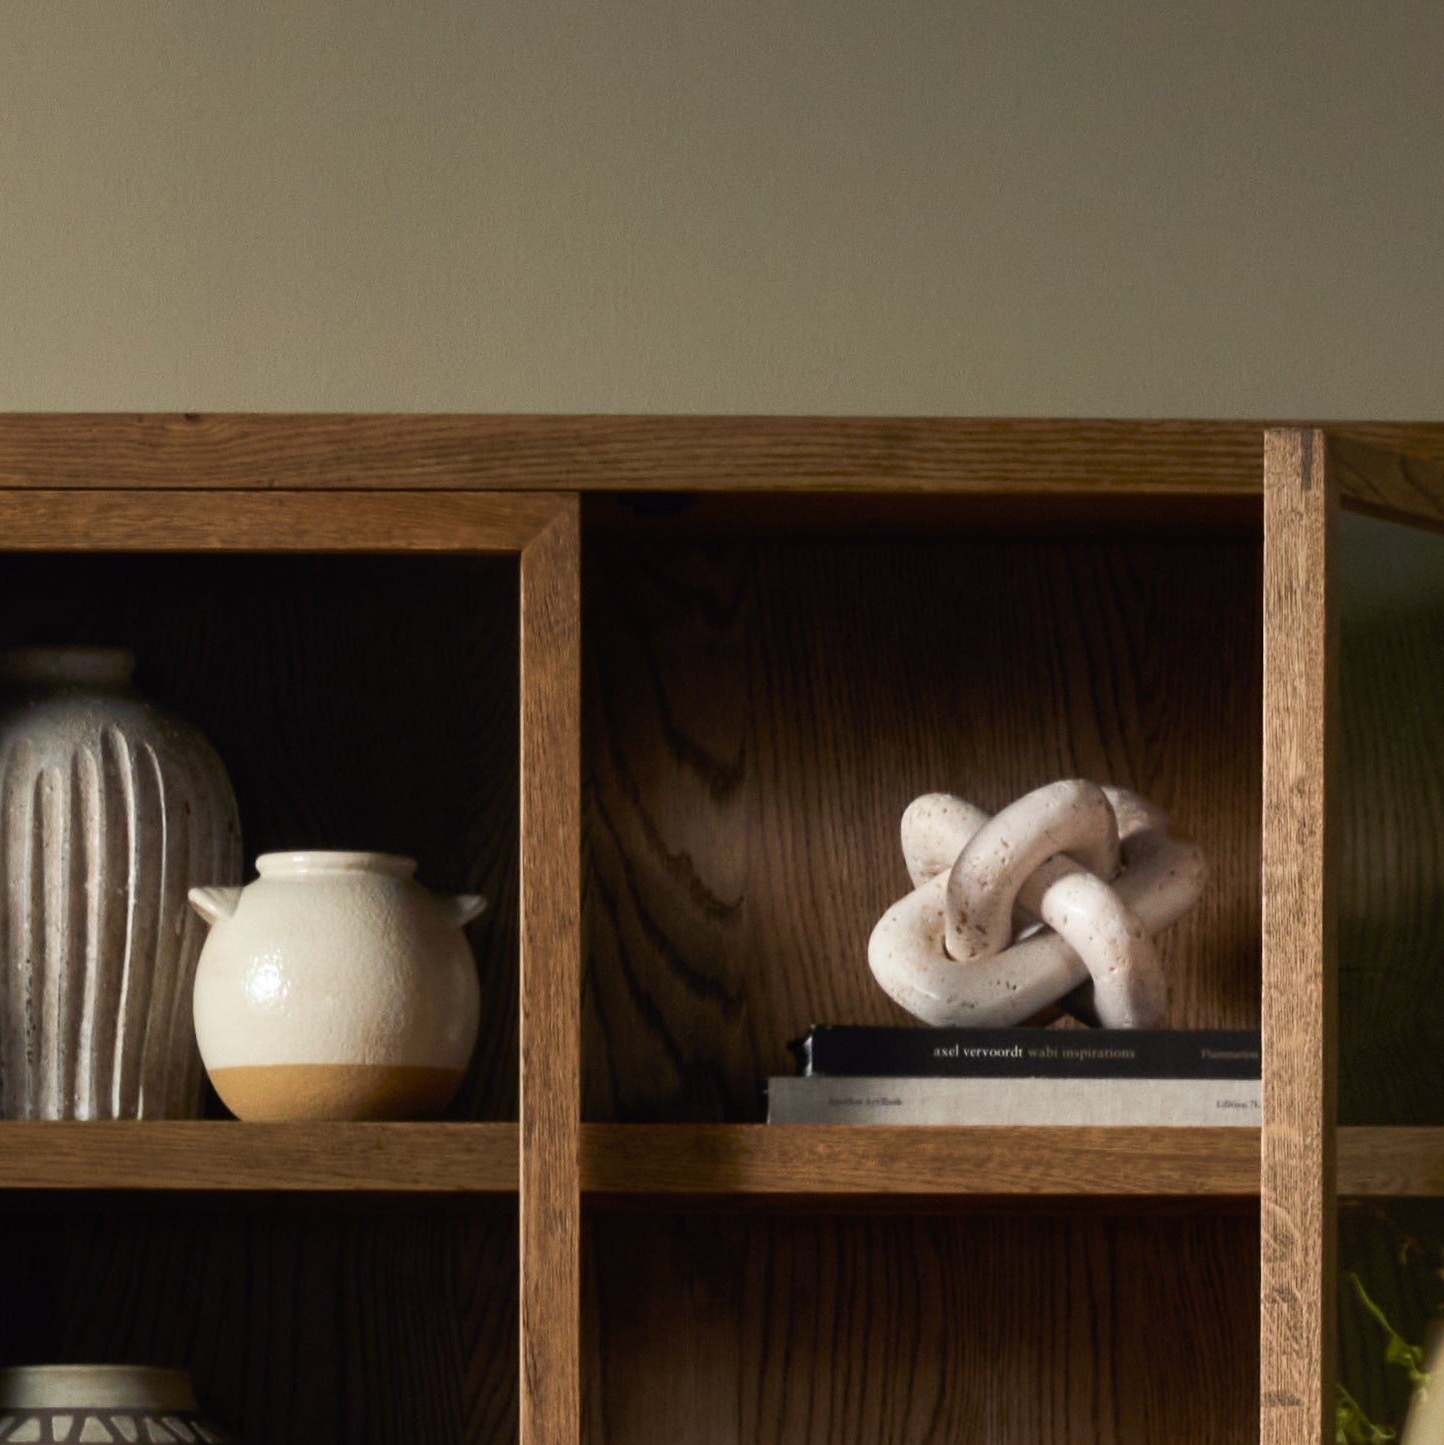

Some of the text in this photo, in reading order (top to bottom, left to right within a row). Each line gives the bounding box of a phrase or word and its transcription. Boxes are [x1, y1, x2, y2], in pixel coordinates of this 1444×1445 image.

[933, 1044, 959, 1058] axel
[963, 1044, 1023, 1058] vervoordt
[1062, 1046, 1135, 1061] inspirations
